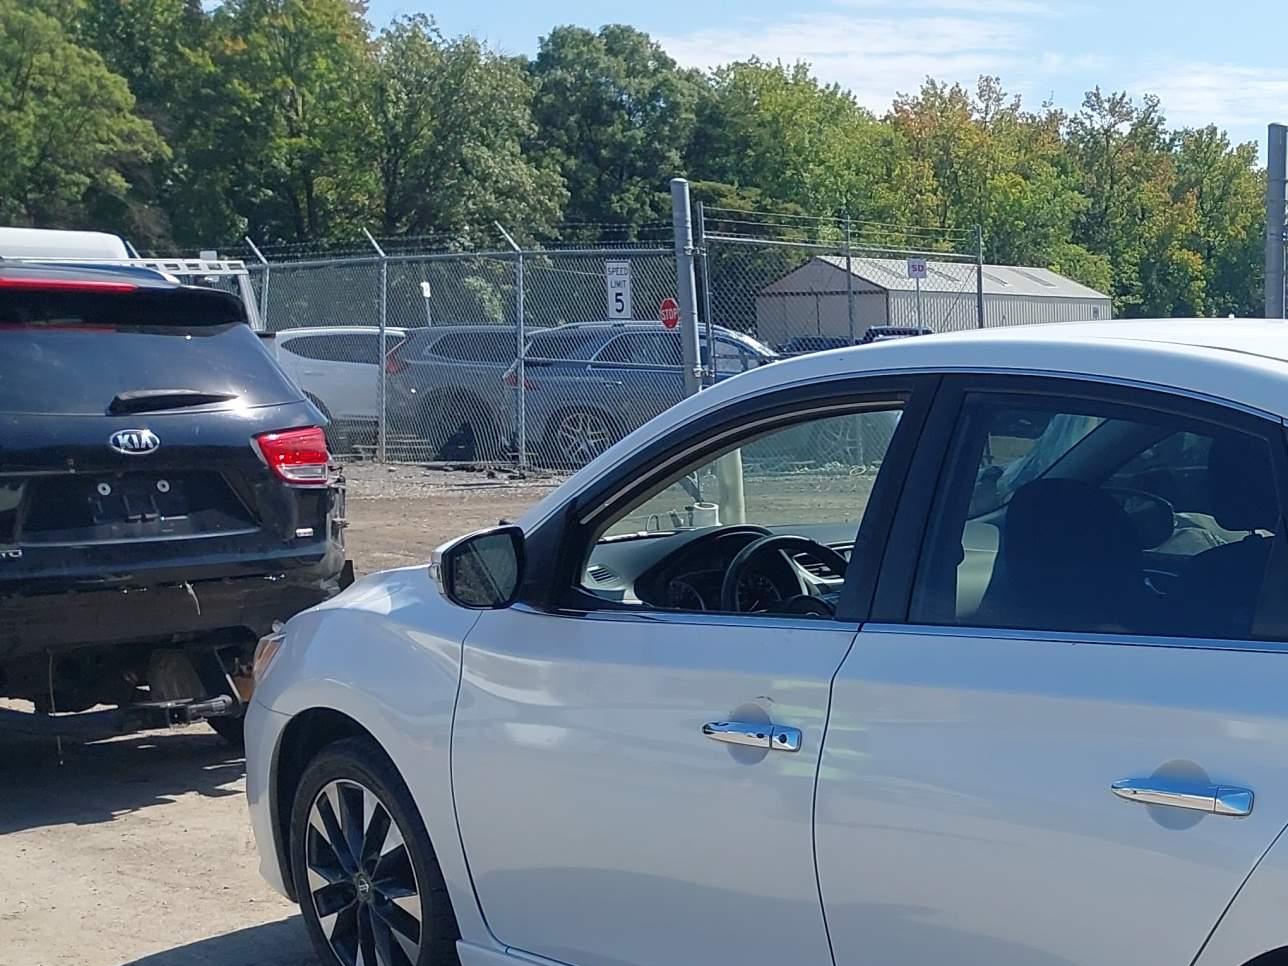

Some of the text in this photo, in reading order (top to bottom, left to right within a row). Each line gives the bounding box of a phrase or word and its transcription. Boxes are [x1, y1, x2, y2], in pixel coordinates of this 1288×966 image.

[608, 267, 628, 276] SPEED
[610, 279, 627, 289] LIMIT
[614, 292, 625, 313] 5
[661, 308, 678, 321] STOP
[116, 431, 155, 449] KIA
